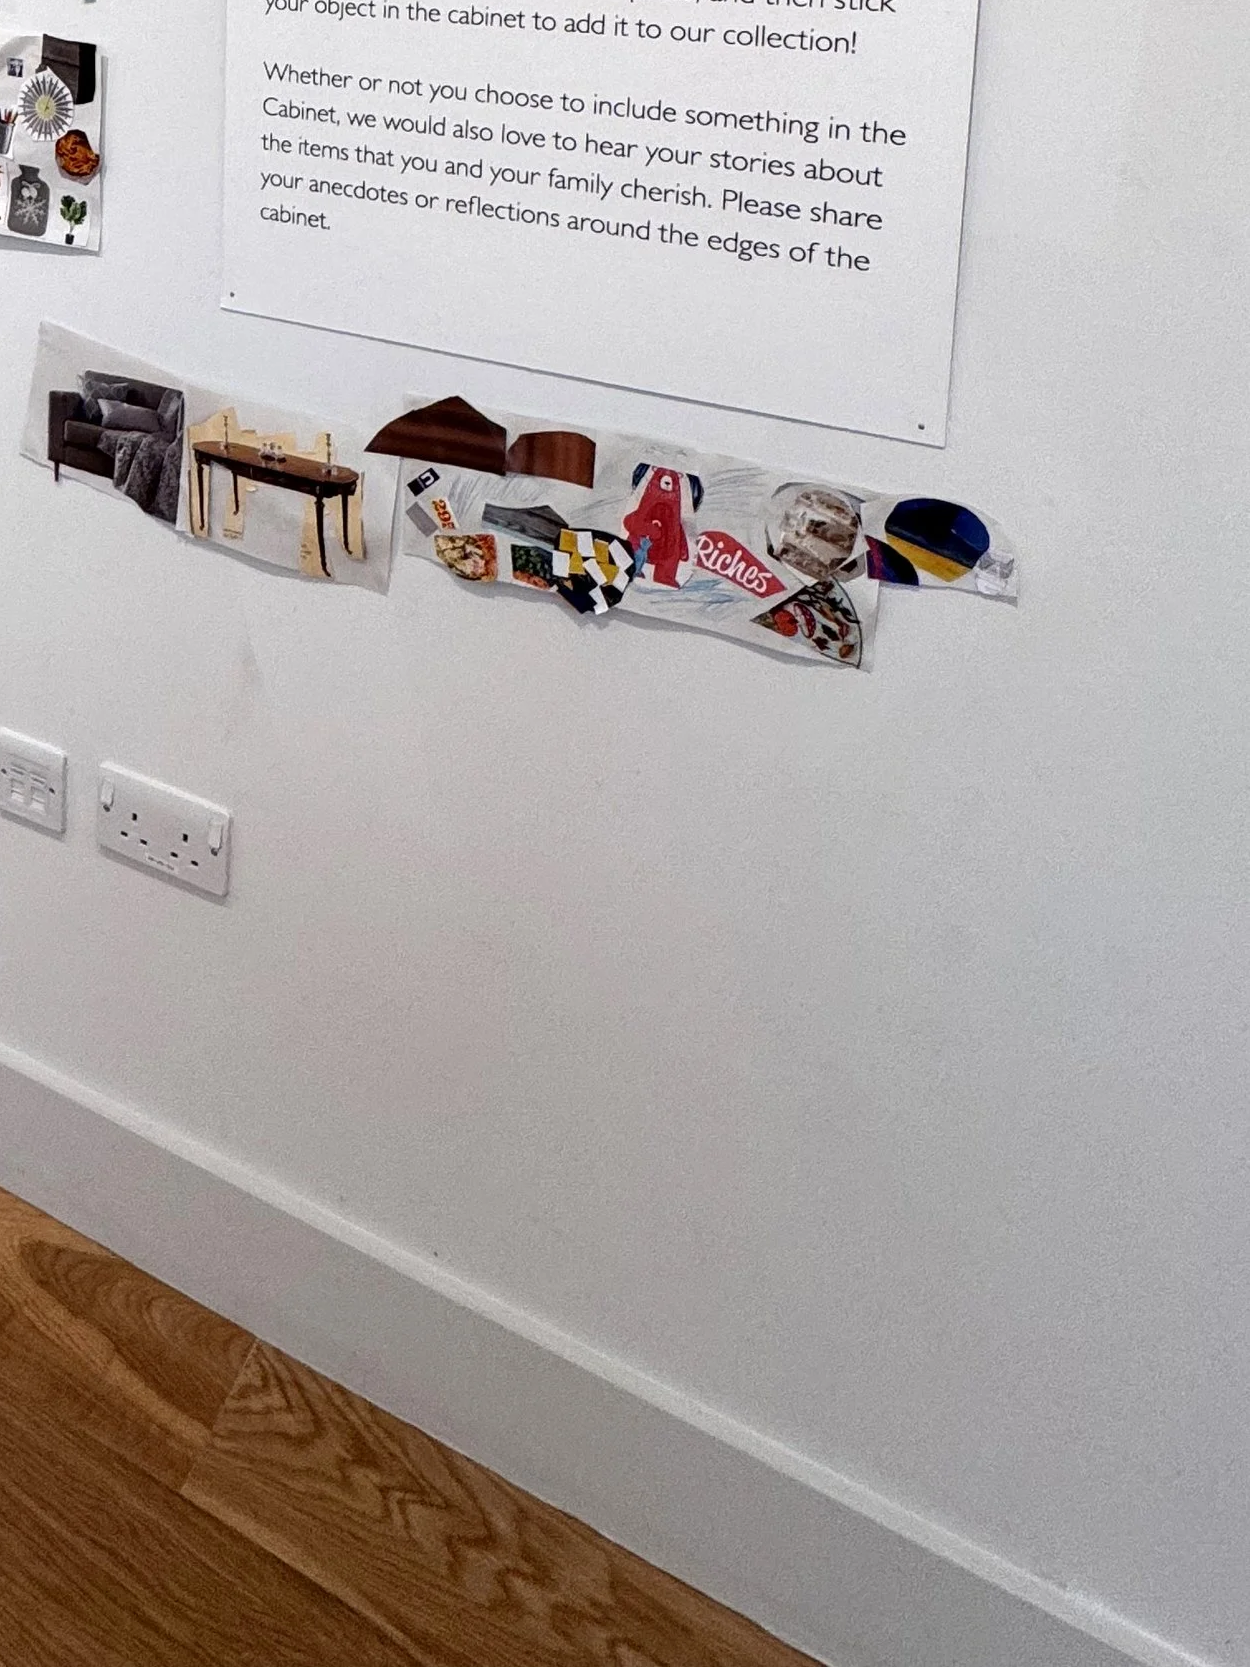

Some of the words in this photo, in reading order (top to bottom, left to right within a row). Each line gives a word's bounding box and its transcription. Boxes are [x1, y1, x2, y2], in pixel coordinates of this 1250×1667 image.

[405, 0, 442, 23] the
[447, 4, 526, 30] cabinet
[531, 11, 557, 32] to
[563, 12, 606, 36] add
[613, 14, 629, 37] it
[634, 18, 662, 40] to
[669, 25, 716, 43] our
[722, 24, 857, 55] collection!
[262, 60, 354, 89] Whether
[358, 76, 383, 92] or
[388, 78, 424, 97] not
[428, 83, 468, 104] you
[474, 82, 554, 110] choose
[559, 93, 585, 113] to
[593, 93, 677, 123] include
[684, 108, 820, 144] something
[828, 115, 851, 141] in
[858, 120, 907, 147] the
[262, 96, 341, 127] Cabinet,
[346, 111, 377, 129] we
[382, 114, 447, 137] would
[452, 118, 494, 142] also
[501, 123, 546, 149] love
[551, 131, 578, 152] to
[584, 132, 639, 159] hear
[644, 145, 703, 168] your
[709, 149, 796, 178] stories
[803, 157, 884, 188] about
[259, 203, 331, 231] cabinet.
[260, 132, 293, 154] the
[298, 135, 350, 162] items
[354, 144, 395, 168] that
[400, 154, 438, 175] you
[444, 158, 483, 179] and
[489, 165, 542, 187] your
[547, 167, 614, 202] family
[620, 177, 713, 209] cherish.
[722, 188, 802, 221] Please
[809, 200, 883, 231] share
[260, 171, 304, 191] your
[308, 178, 409, 206] anecdotes
[414, 193, 440, 210] or
[445, 195, 561, 228] reflections
[566, 215, 651, 242] around
[657, 222, 700, 248] the
[706, 231, 781, 262] edges
[788, 241, 821, 265] of
[823, 245, 871, 272] the
[697, 534, 772, 593] Riches
